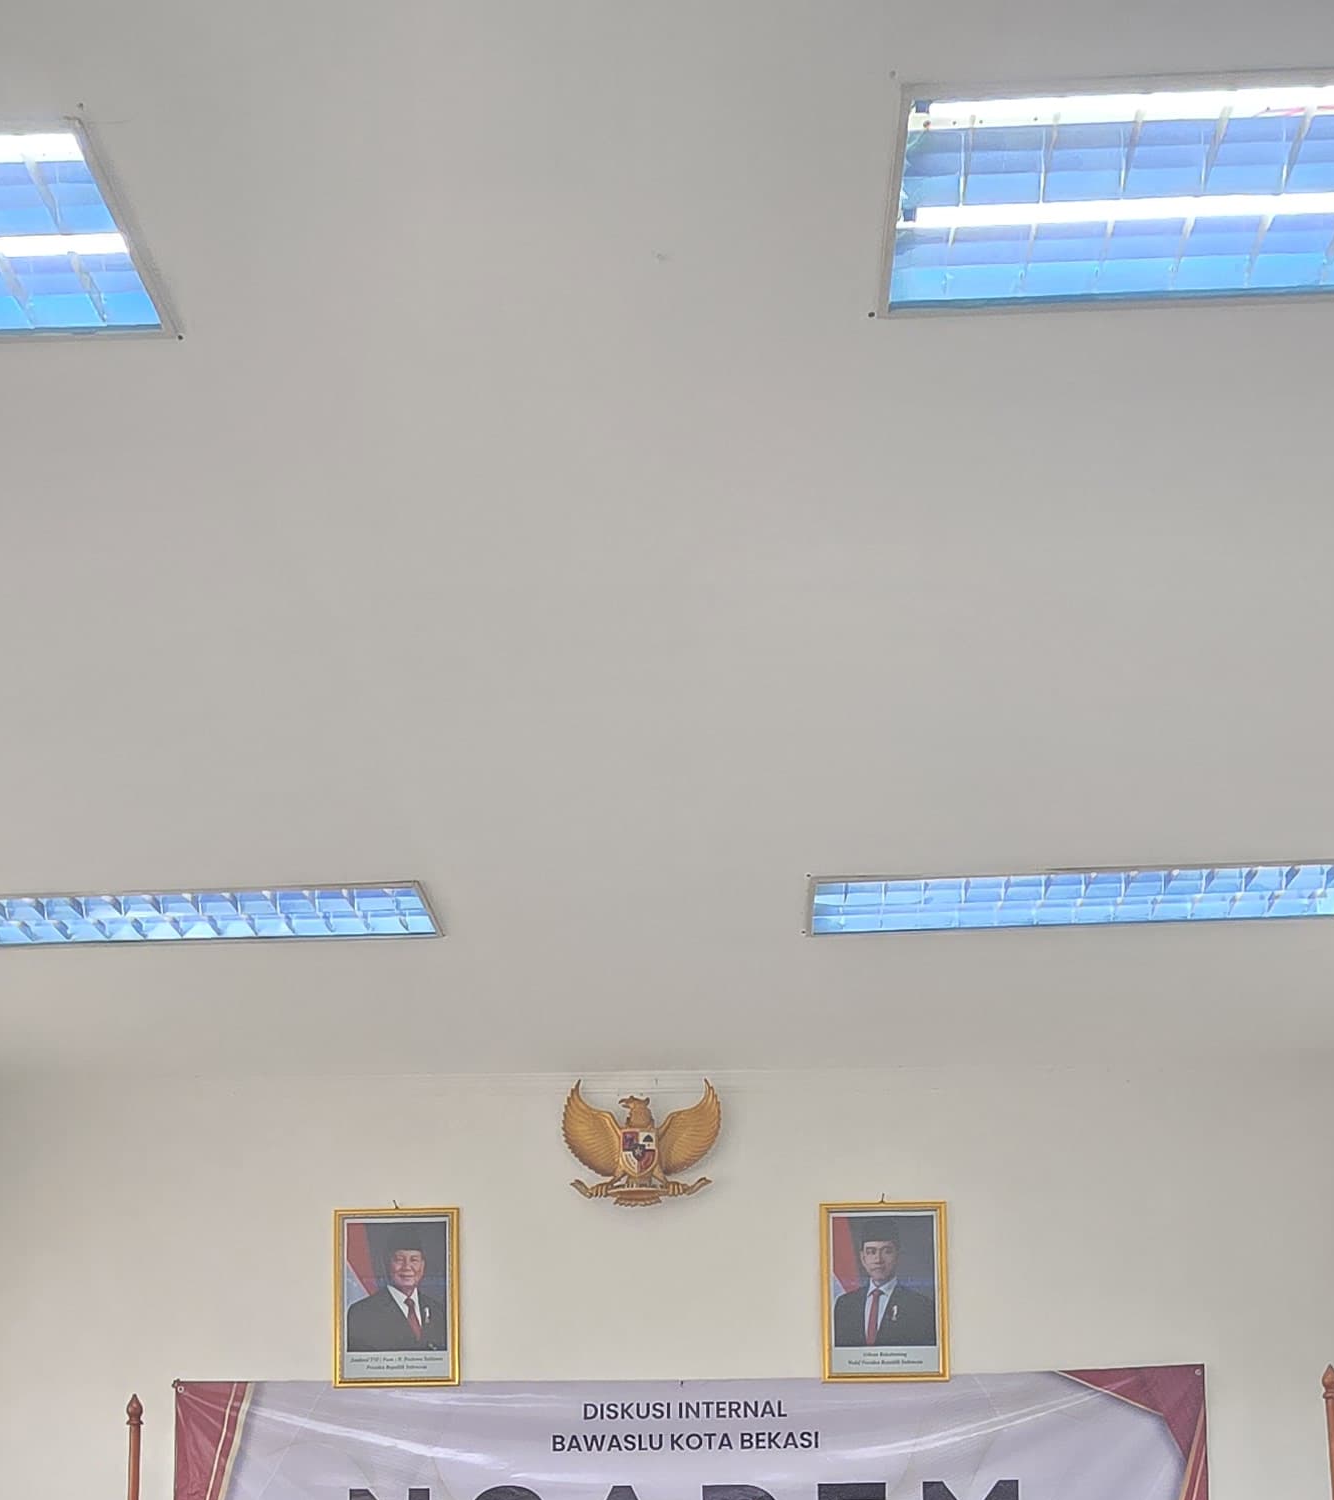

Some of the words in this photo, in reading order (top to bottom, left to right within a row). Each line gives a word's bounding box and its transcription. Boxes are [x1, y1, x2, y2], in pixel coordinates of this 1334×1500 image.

[583, 1402, 671, 1420] DISKUSI
[678, 1400, 788, 1419] INTERNAL
[552, 1433, 664, 1452] BAWASLU
[670, 1432, 733, 1451] KOTA
[739, 1431, 820, 1450] BEKASI
